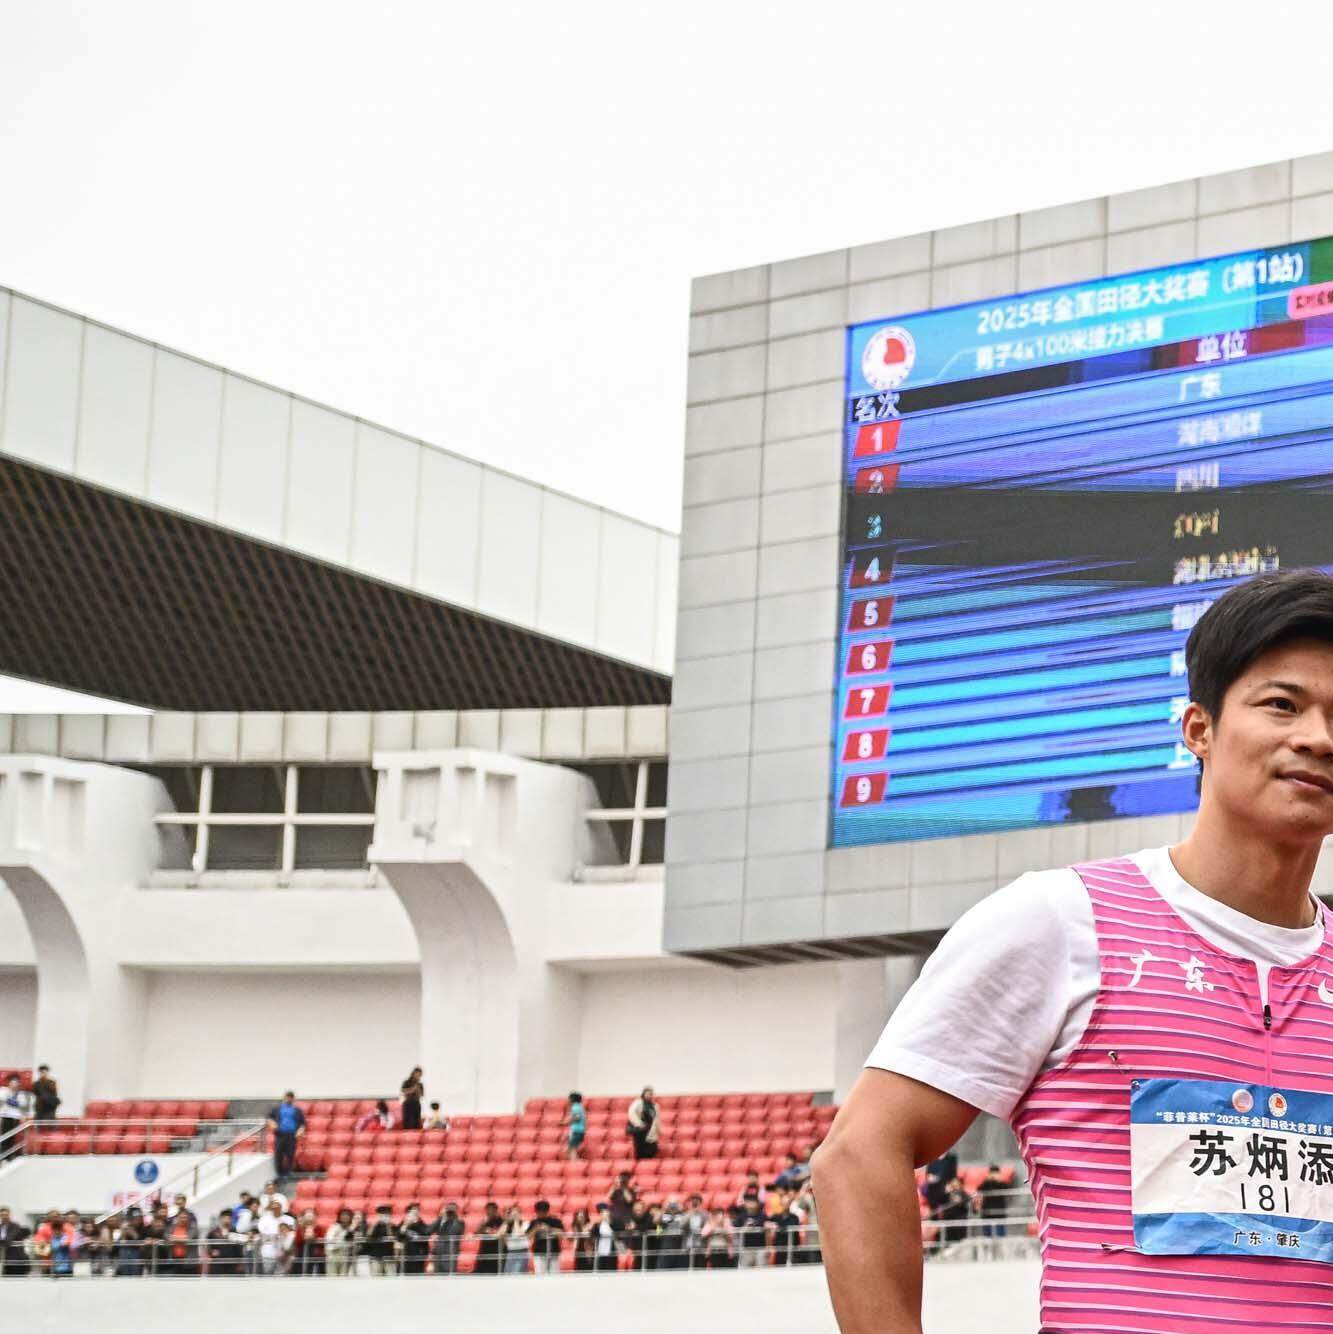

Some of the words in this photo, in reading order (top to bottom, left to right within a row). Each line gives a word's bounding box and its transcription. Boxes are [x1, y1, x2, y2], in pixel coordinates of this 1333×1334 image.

[1195, 330, 1248, 362] 单位
[1179, 372, 1222, 401] 广东
[853, 392, 900, 422] 名次
[871, 429, 883, 450] 1
[867, 470, 885, 494] 2
[865, 512, 883, 539] 3
[864, 556, 881, 582] 4
[863, 600, 879, 626] 5
[861, 643, 877, 669] 6
[860, 688, 876, 714] 7
[858, 732, 873, 758] 8
[856, 776, 872, 803] 9
[1128, 948, 1215, 993] 广东
[1240, 1182, 1290, 1213] 181
